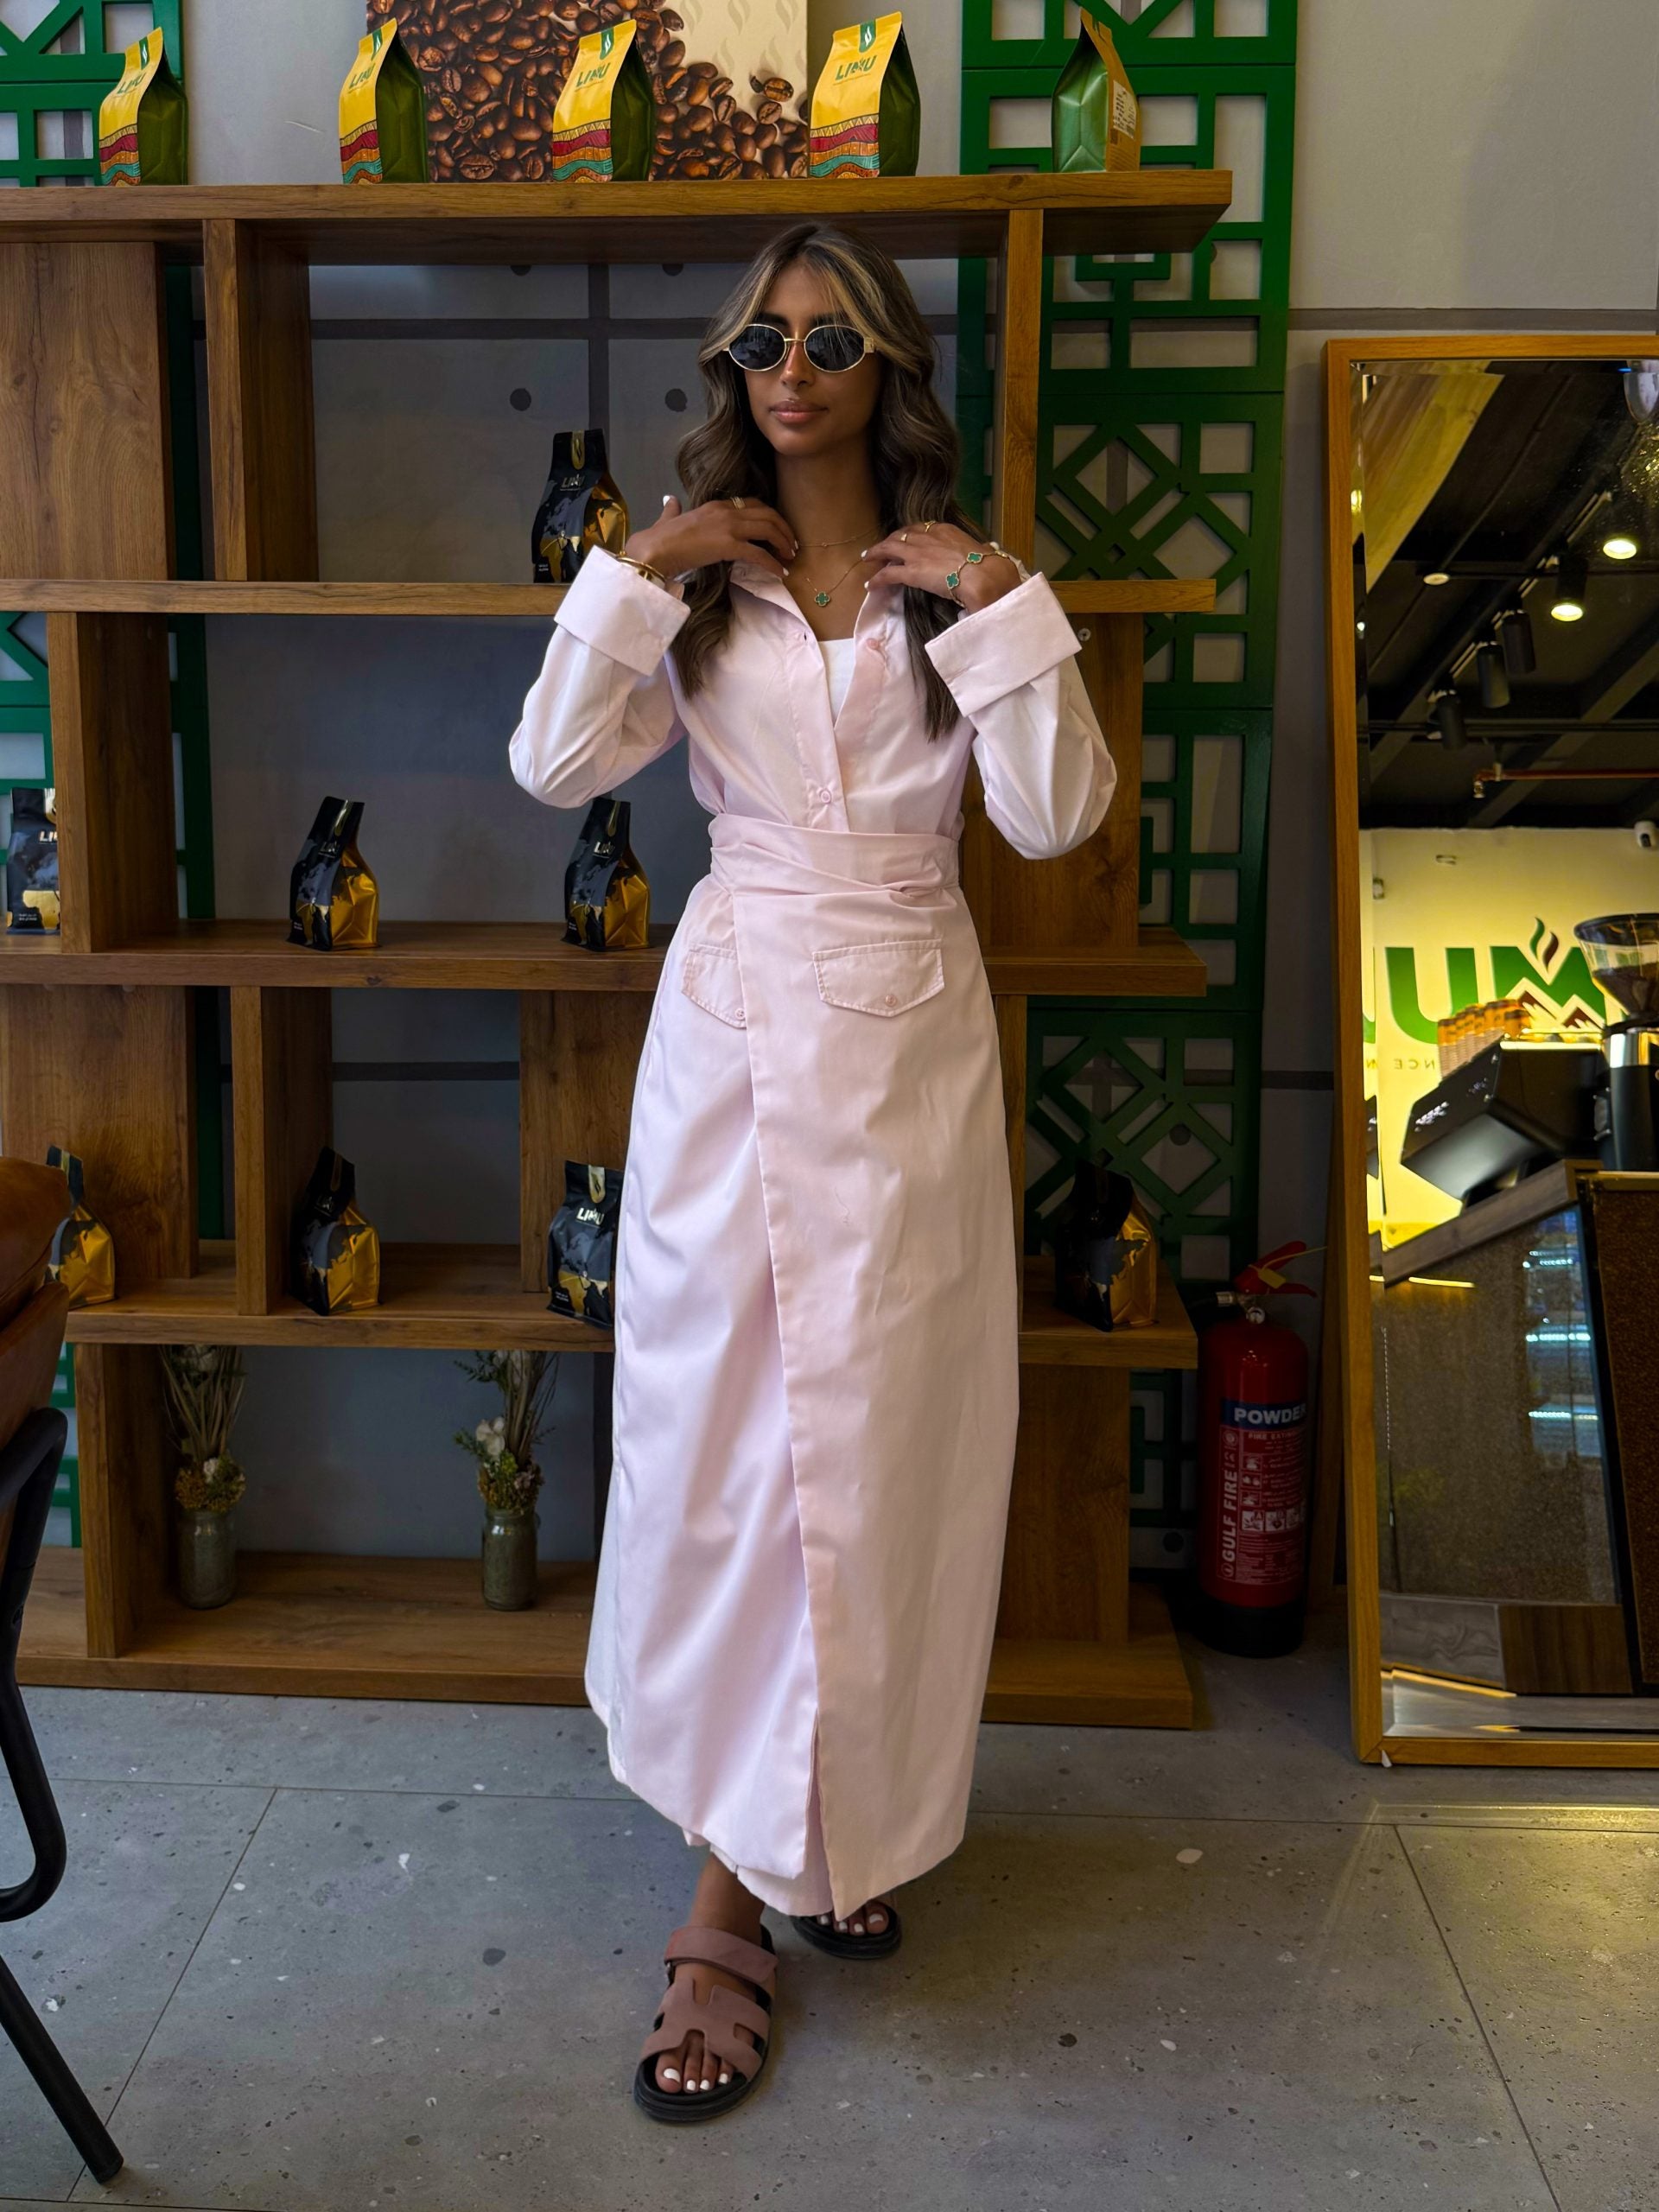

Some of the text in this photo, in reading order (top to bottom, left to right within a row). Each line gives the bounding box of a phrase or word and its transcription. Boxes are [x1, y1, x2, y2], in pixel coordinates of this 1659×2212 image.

[835, 55, 877, 80] LIMU
[39, 830, 59, 842] LI
[1221, 1469, 1238, 1563] GULF FIRE
